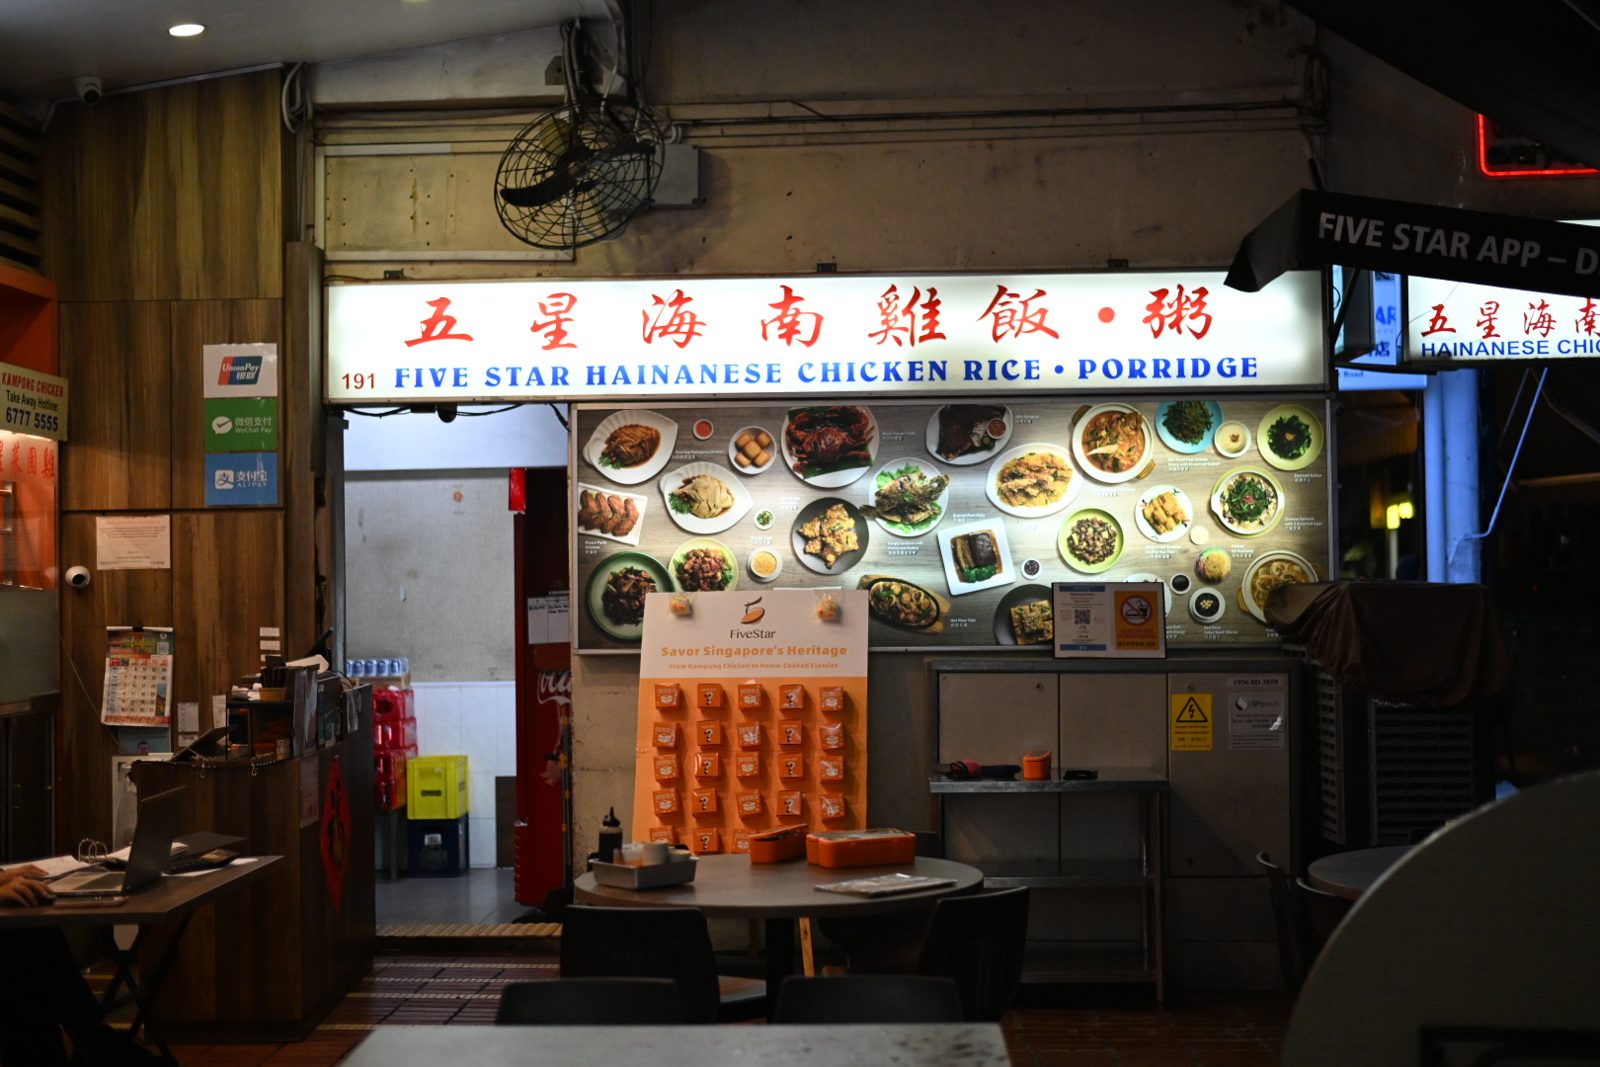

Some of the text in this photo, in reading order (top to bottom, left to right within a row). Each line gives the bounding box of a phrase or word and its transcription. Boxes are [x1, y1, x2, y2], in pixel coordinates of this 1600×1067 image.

[1318, 212, 1384, 248] FIVE
[1392, 223, 1471, 261] STAR
[1477, 235, 1542, 268] APP
[1575, 247, 1600, 275] D
[1422, 341, 1549, 358] HAINANESE
[222, 363, 259, 376] UnionPay
[342, 373, 376, 389] 191
[394, 367, 468, 388] FIVE
[485, 366, 570, 387] STAR
[586, 363, 782, 385] HAINANESE
[798, 360, 948, 383] CHICKEN
[963, 359, 1040, 381] RICE
[1078, 356, 1258, 380] PORRIDGE
[36, 380, 64, 398] CHICKEN
[6, 390, 21, 403] Take
[21, 393, 37, 409] Away
[6, 407, 59, 432] 6777 5555
[235, 417, 272, 427] 微信支付
[236, 470, 268, 481] 支付宝
[729, 628, 777, 639] FiveStar
[661, 644, 849, 659] Savor Singapore's Heritage
